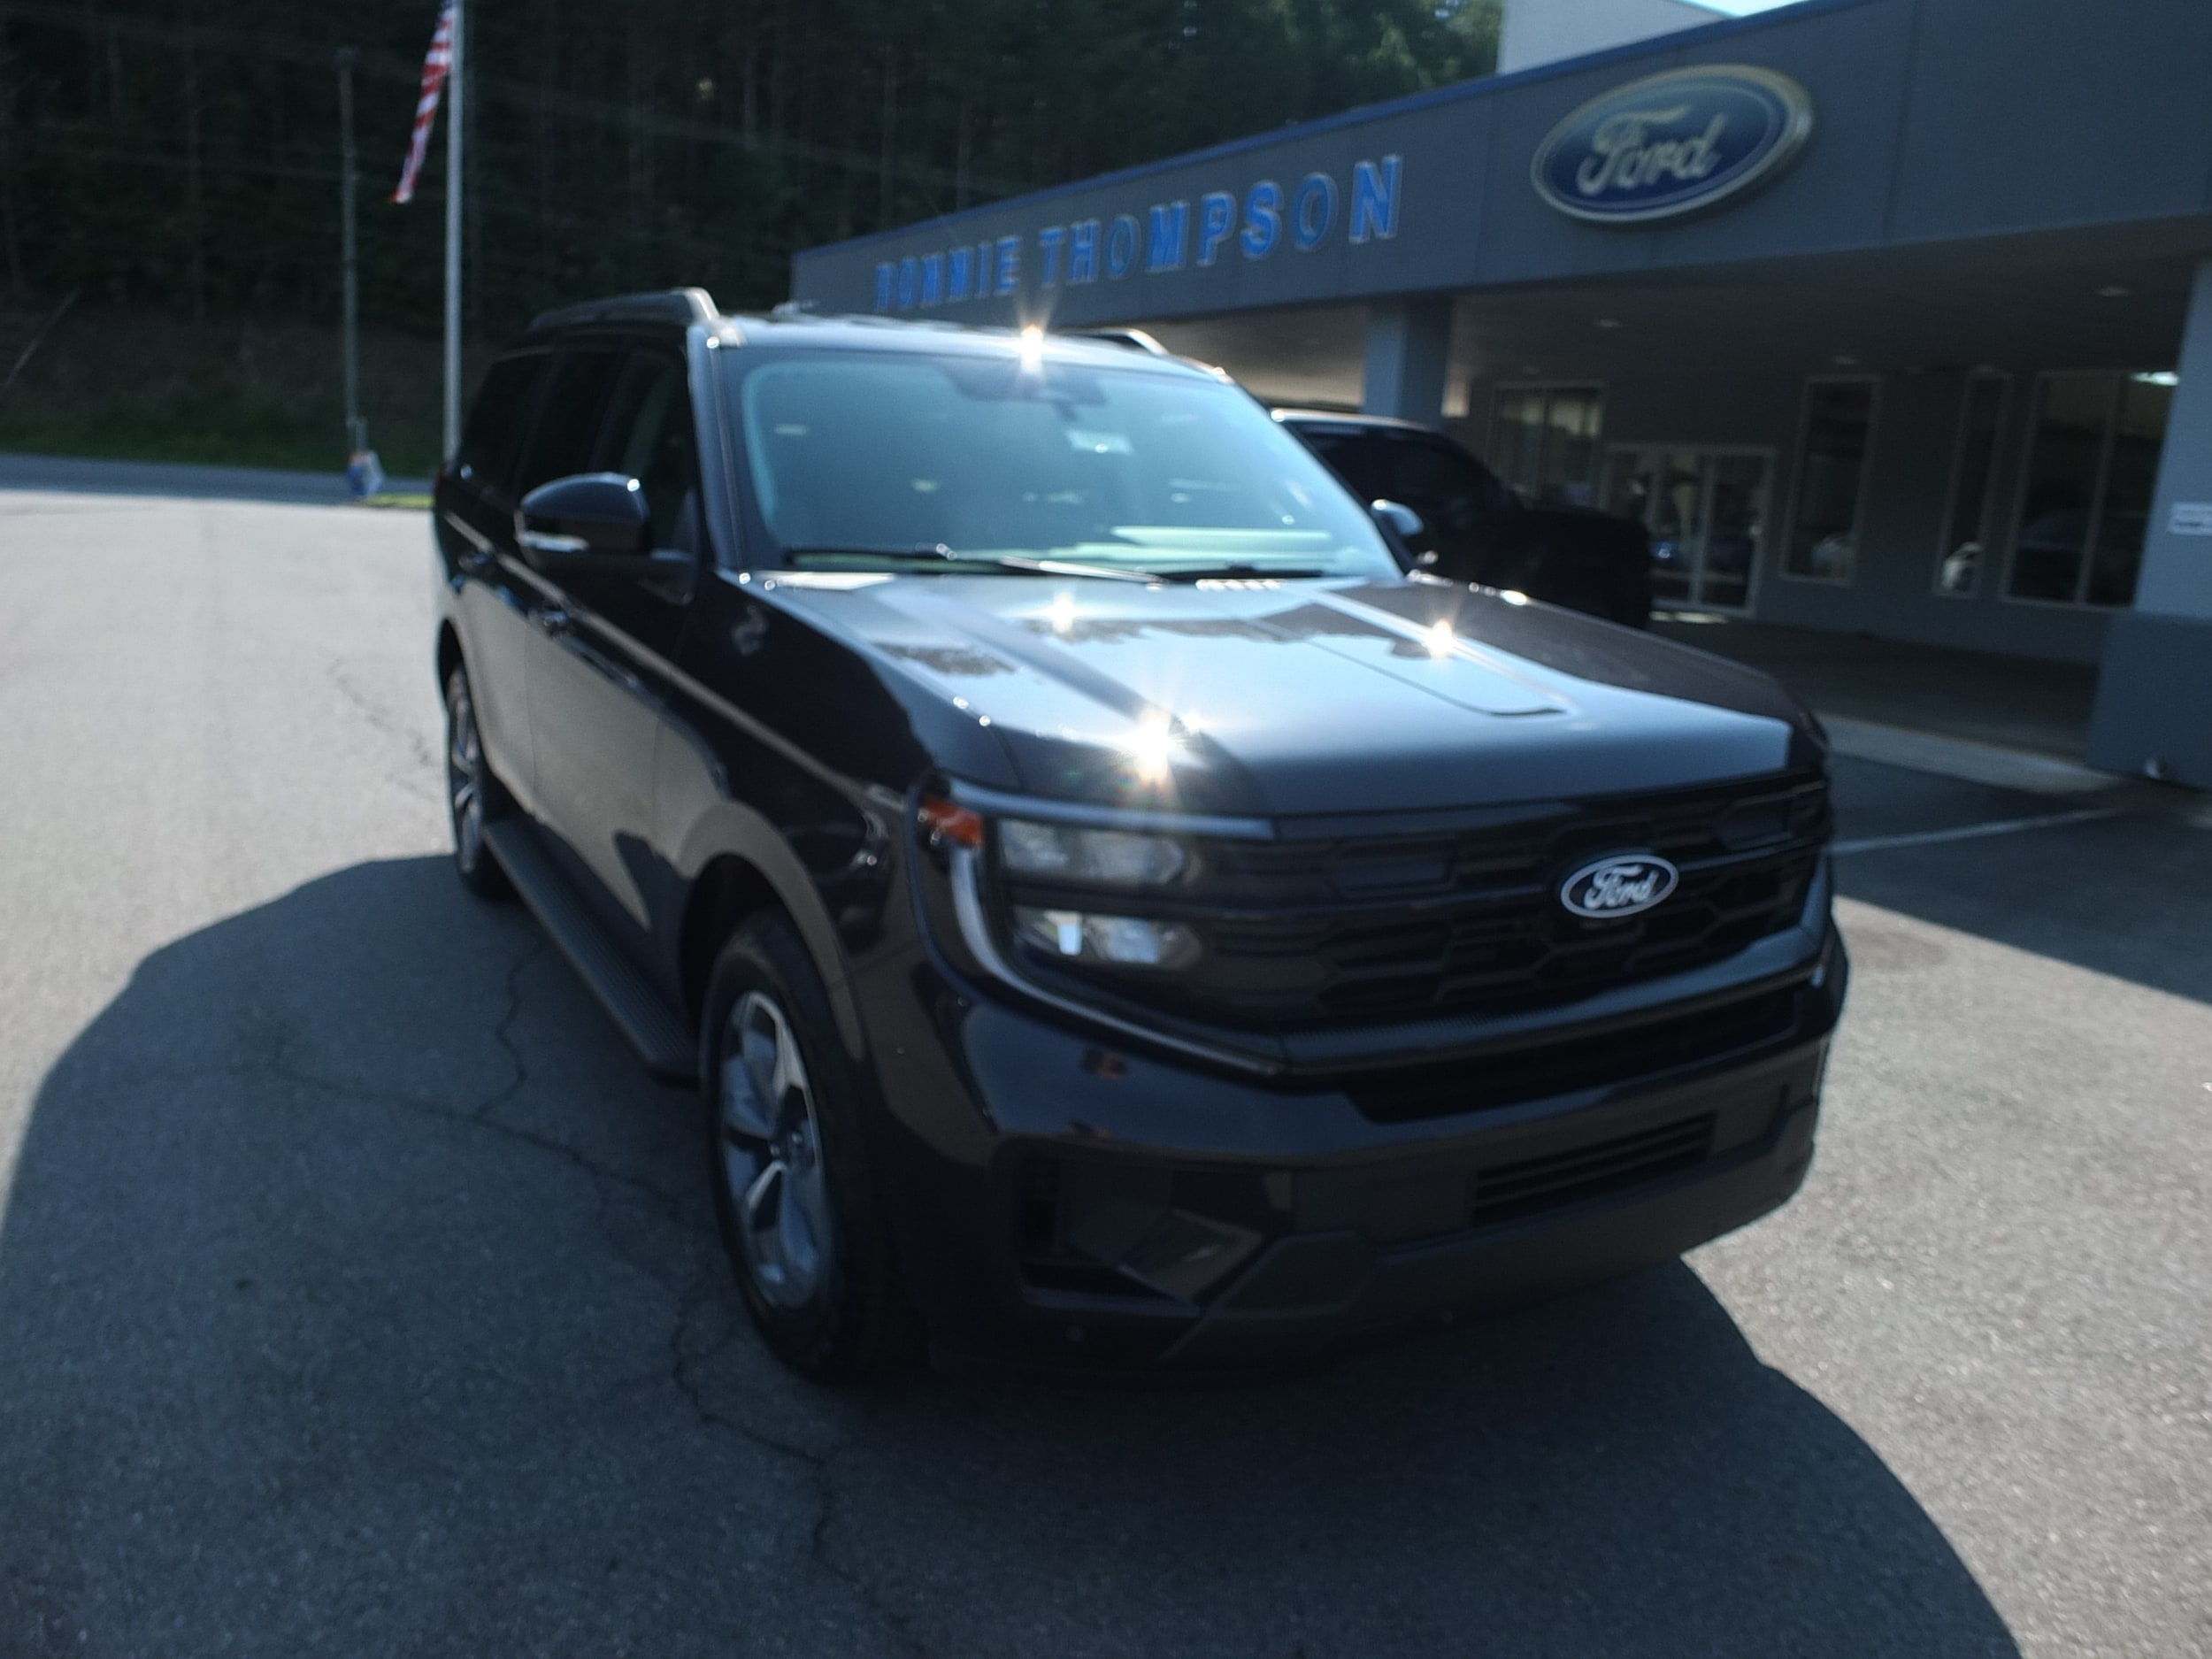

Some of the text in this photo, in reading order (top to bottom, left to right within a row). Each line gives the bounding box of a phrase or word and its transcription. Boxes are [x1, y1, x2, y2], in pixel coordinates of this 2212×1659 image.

[1576, 104, 1727, 196] Ford
[1038, 153, 1404, 288] THOMPSON
[1584, 864, 1660, 910] Ford
